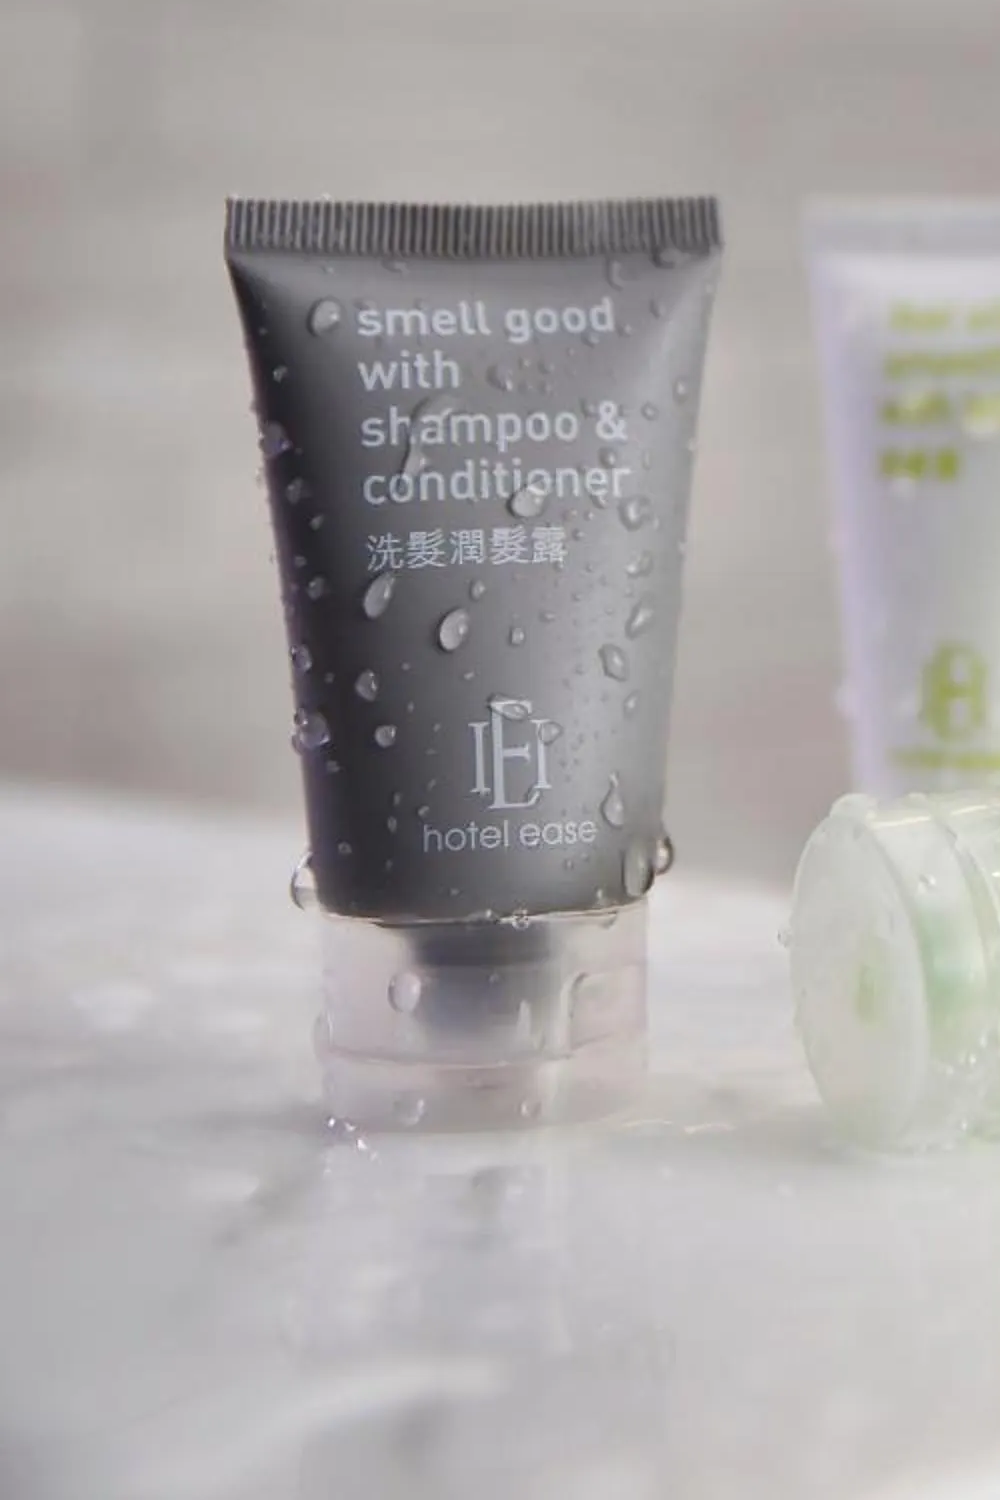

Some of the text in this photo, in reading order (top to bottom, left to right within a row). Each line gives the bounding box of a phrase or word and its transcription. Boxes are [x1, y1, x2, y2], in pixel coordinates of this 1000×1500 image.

[357, 297, 616, 343] smell good
[357, 349, 462, 391] with
[360, 400, 628, 454] shampoo &
[362, 456, 632, 506] conditioner
[366, 523, 569, 572] 洗髮潤髮露
[422, 819, 600, 853] hotel ease
